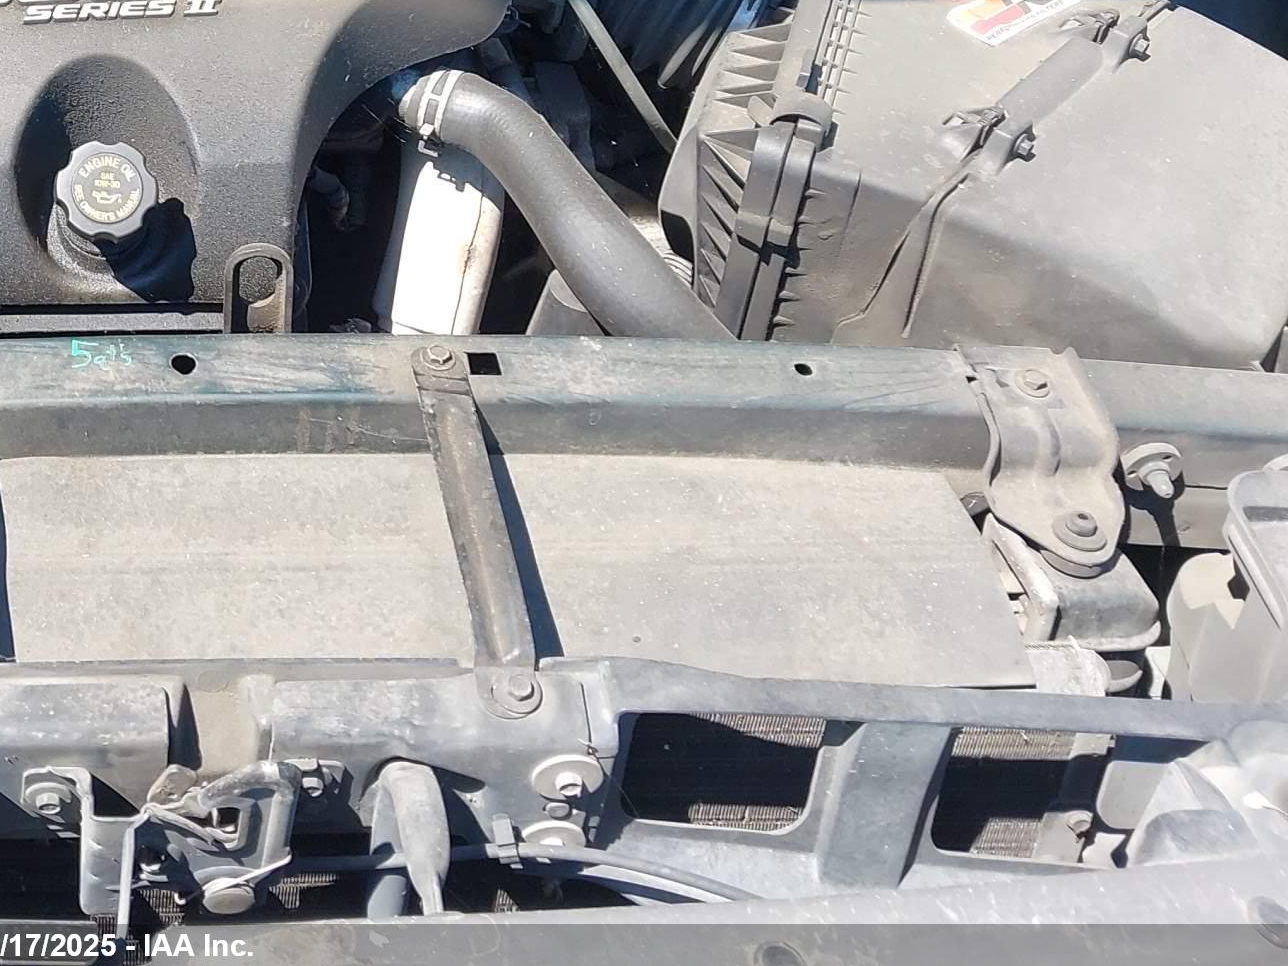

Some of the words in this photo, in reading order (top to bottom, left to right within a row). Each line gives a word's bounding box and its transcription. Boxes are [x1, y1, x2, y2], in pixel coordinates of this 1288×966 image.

[23, 0, 176, 25] SERIES
[78, 156, 120, 178] ENGINE
[120, 163, 136, 182] OIL
[100, 172, 114, 180] SAE
[74, 184, 85, 201] SEE
[116, 189, 139, 218] MANUAL
